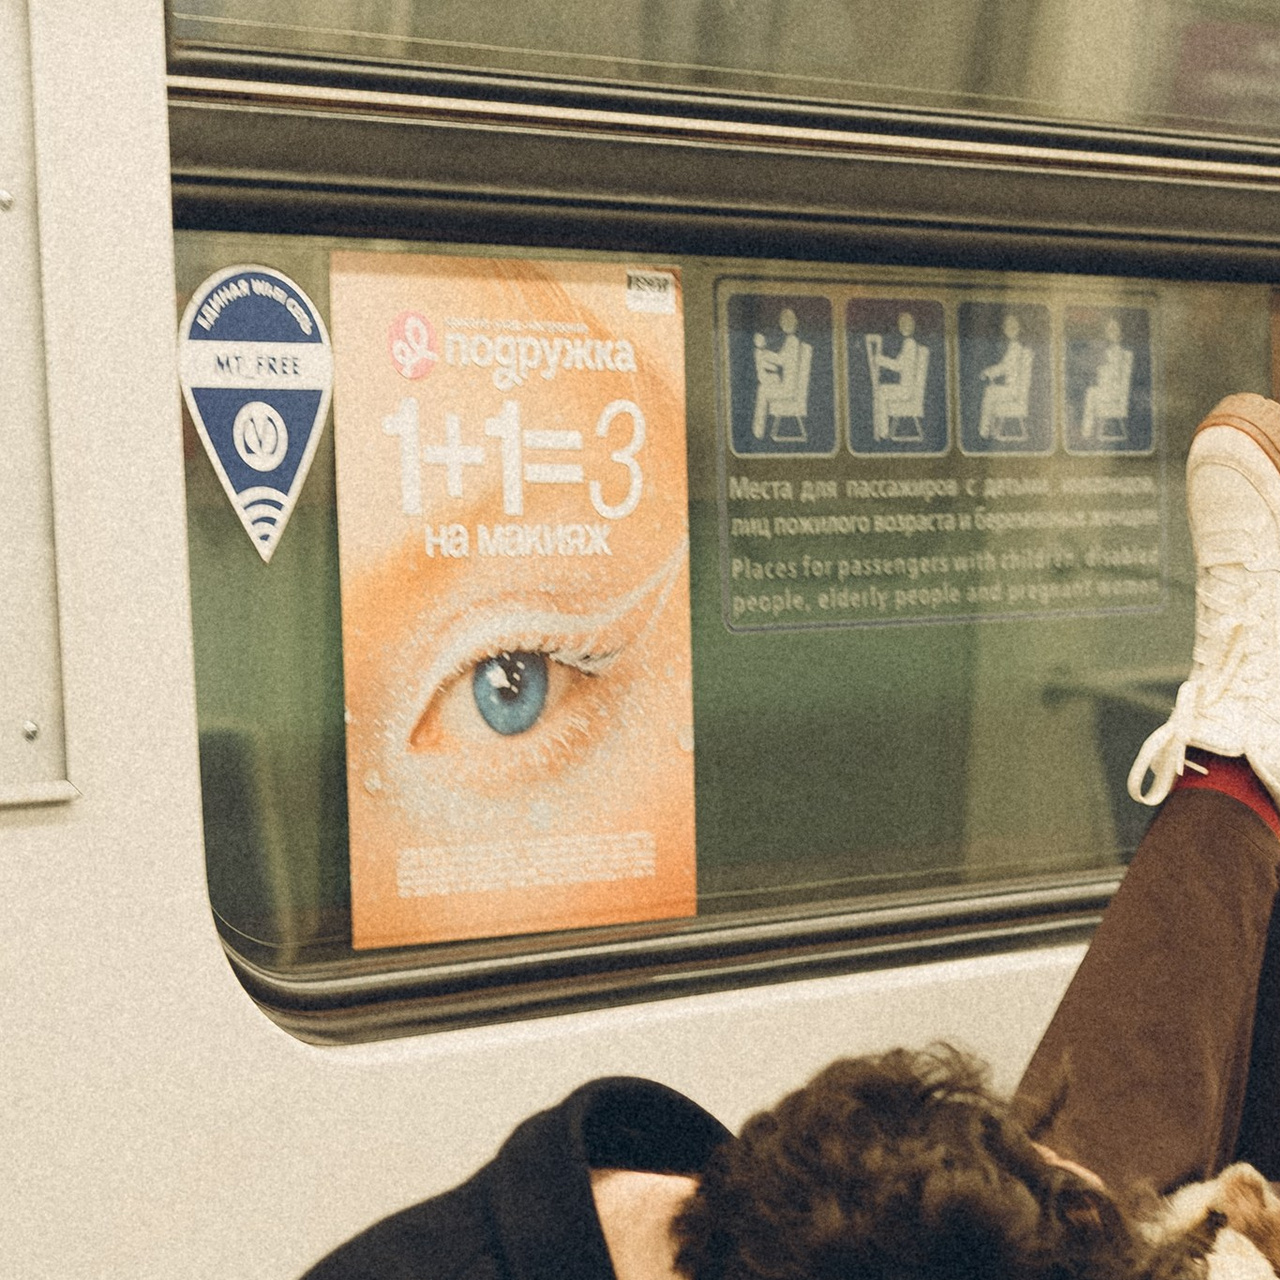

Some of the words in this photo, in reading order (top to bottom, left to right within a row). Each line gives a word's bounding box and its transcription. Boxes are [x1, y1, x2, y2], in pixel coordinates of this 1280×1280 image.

[443, 331, 638, 391] подружка
[729, 476, 793, 500] Места
[801, 479, 837, 503] для
[846, 479, 957, 503] пассажиров
[425, 523, 469, 558] на
[478, 524, 612, 558] макияж
[731, 517, 772, 540] лиц
[774, 515, 871, 536] пожилого
[873, 513, 956, 538] возраста
[958, 513, 972, 530] и
[731, 556, 798, 580] Places
[802, 554, 833, 577] for
[837, 556, 950, 582] passengers
[952, 551, 996, 572] with
[733, 587, 812, 619] people,
[818, 586, 888, 612] elderly
[895, 581, 961, 609] people
